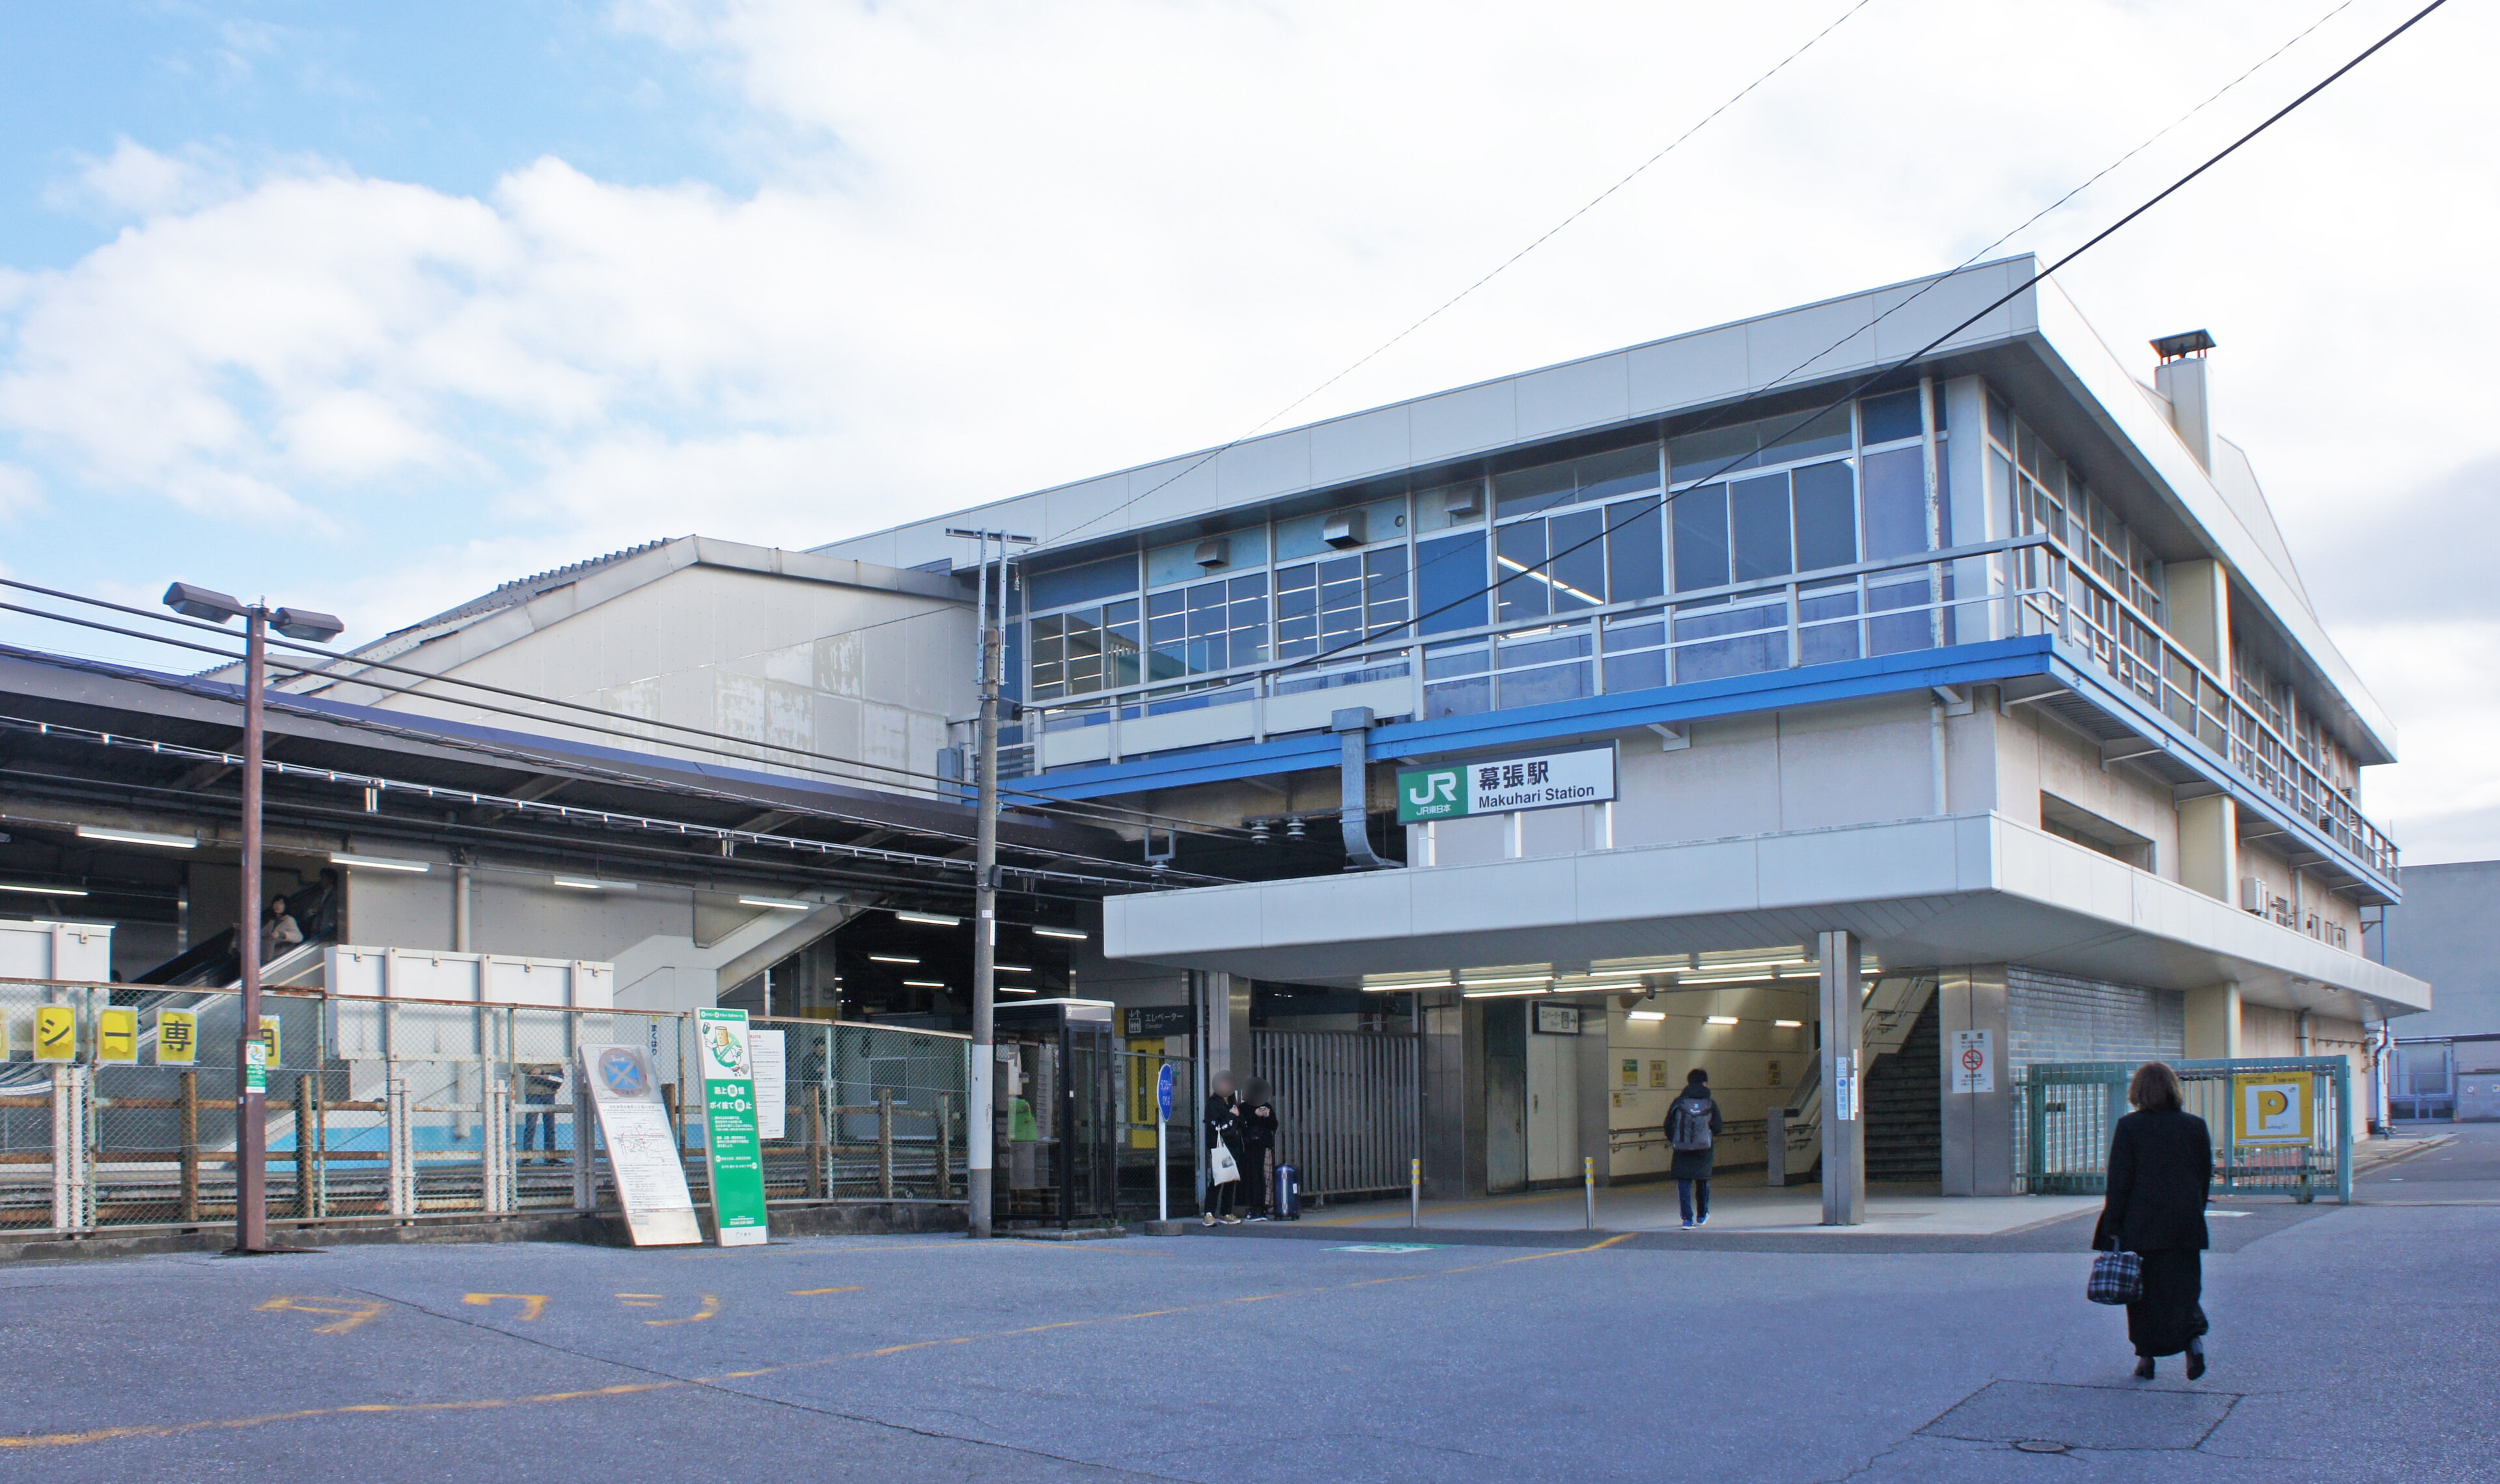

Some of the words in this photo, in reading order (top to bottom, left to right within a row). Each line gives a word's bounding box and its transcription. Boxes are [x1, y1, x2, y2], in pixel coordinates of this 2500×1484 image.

[1479, 760, 1549, 791] 幕張駅
[1410, 772, 1457, 804] JR
[1479, 790, 1540, 808] Makuhari
[1545, 785, 1594, 801] Station
[1416, 804, 1451, 816] JR東日本
[1145, 1013, 1184, 1023] エレベーター
